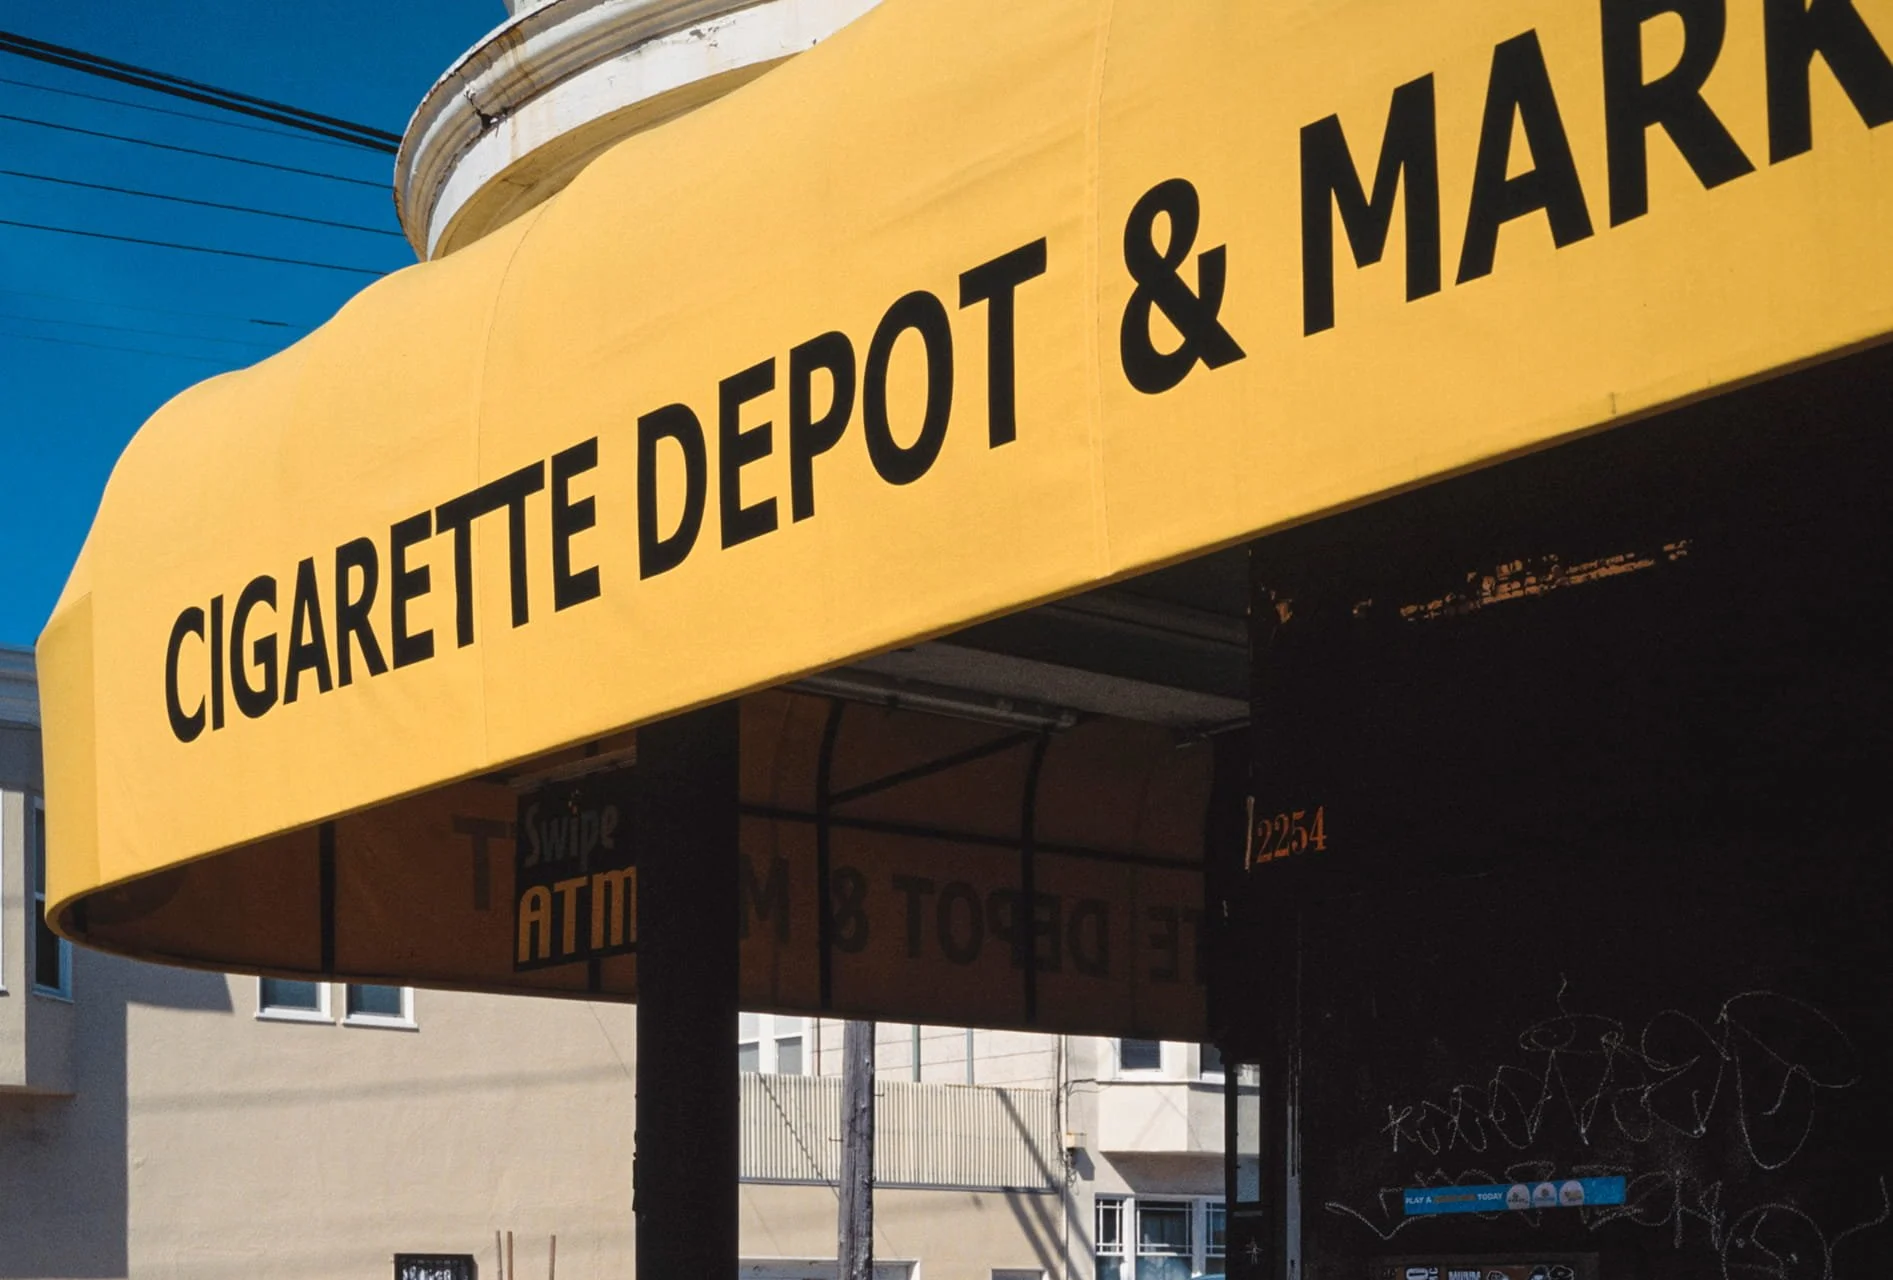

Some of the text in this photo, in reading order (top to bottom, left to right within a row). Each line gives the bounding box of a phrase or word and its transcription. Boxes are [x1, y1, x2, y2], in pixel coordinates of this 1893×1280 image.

[166, 438, 600, 742] CIGARETTE
[638, 239, 1046, 579] DEPOT
[1121, 179, 1245, 393] &
[524, 801, 619, 872] Swipe
[1256, 806, 1327, 863] 2254
[518, 865, 637, 964] ATM
[1477, 1192, 1503, 1200] TODAY
